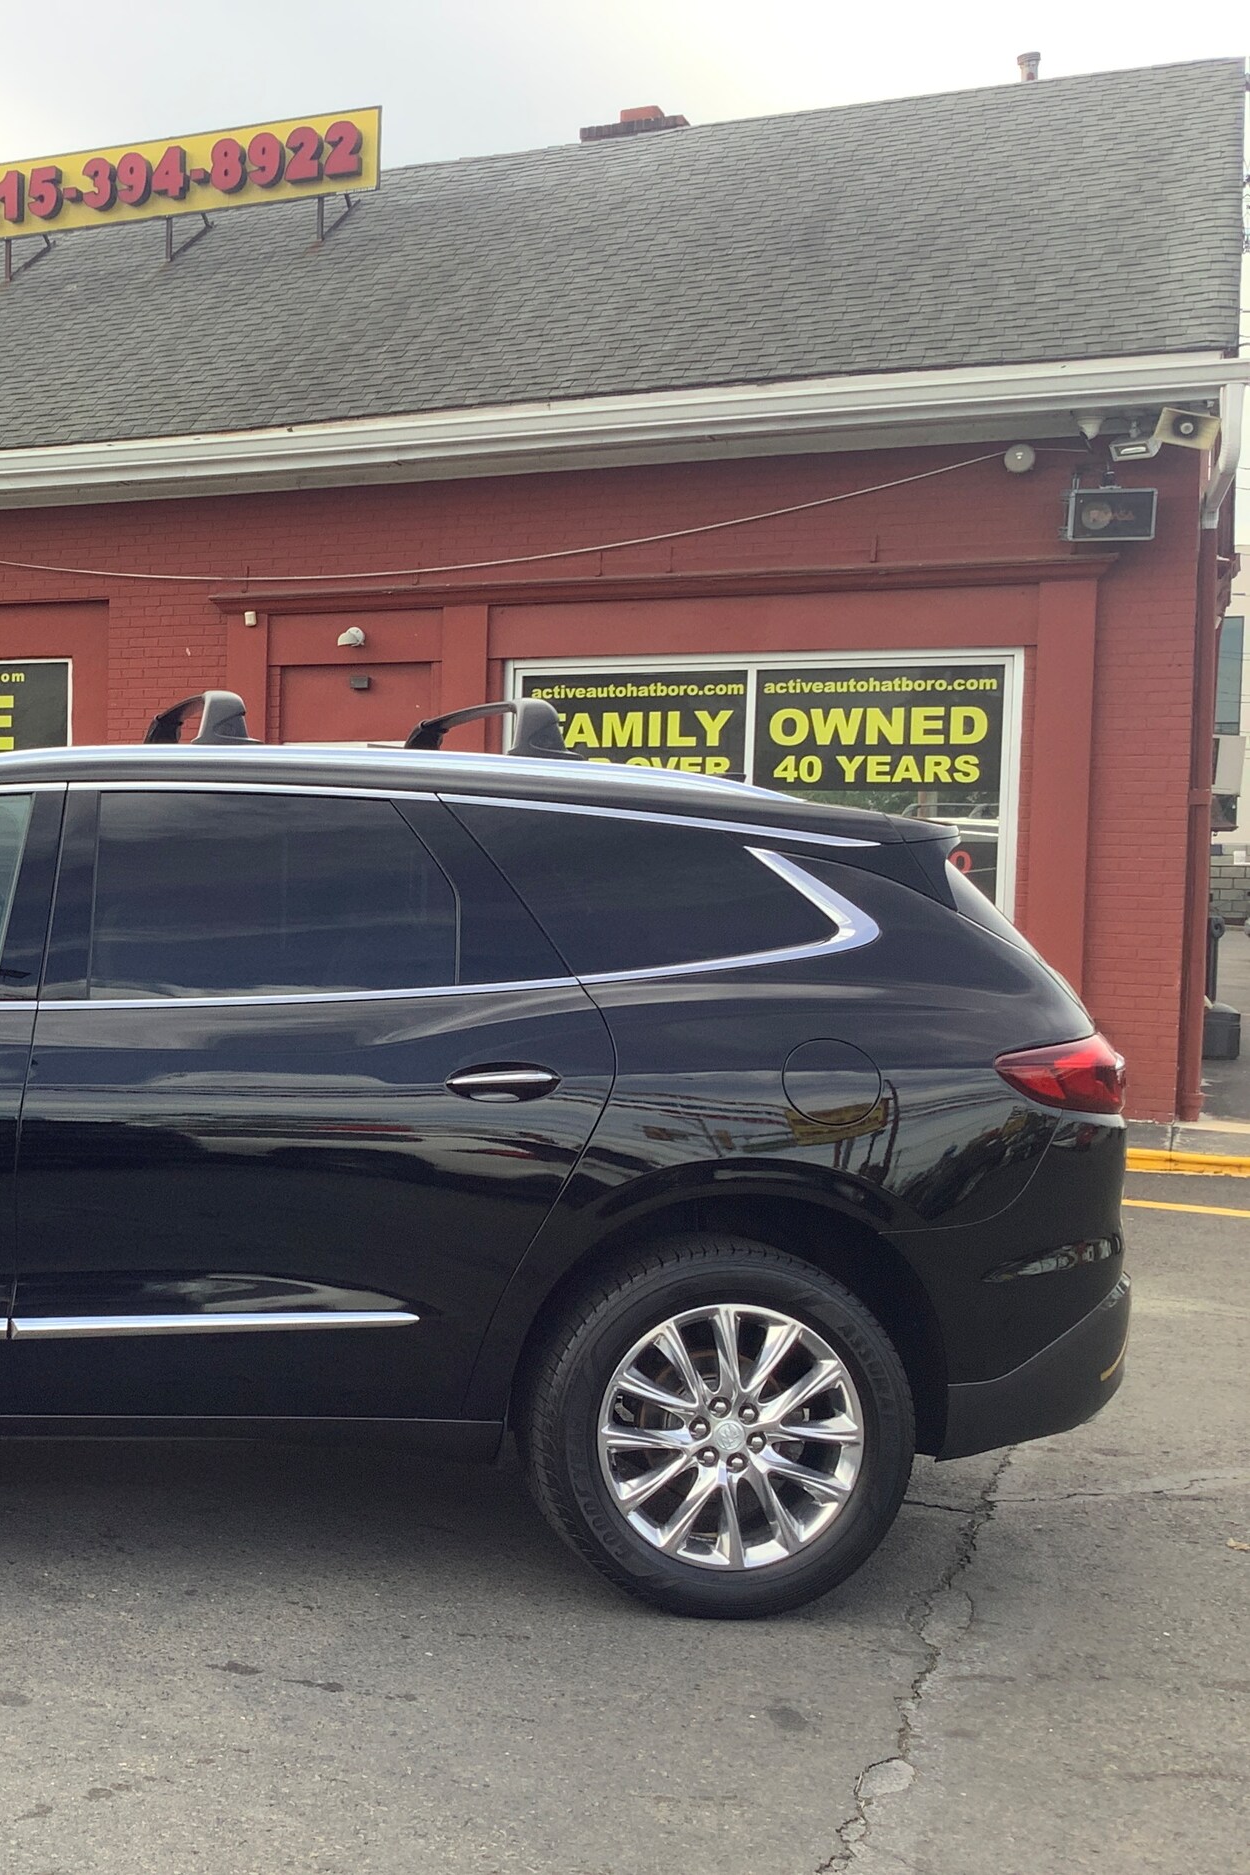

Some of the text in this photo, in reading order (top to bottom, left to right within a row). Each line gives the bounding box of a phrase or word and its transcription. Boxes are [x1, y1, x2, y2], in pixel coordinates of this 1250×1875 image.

[531, 683, 744, 699] activeautohatboro.com
[763, 677, 997, 693] activeautohatboro.com
[769, 706, 988, 746] OWNED
[773, 755, 980, 783] 40 YEARS
